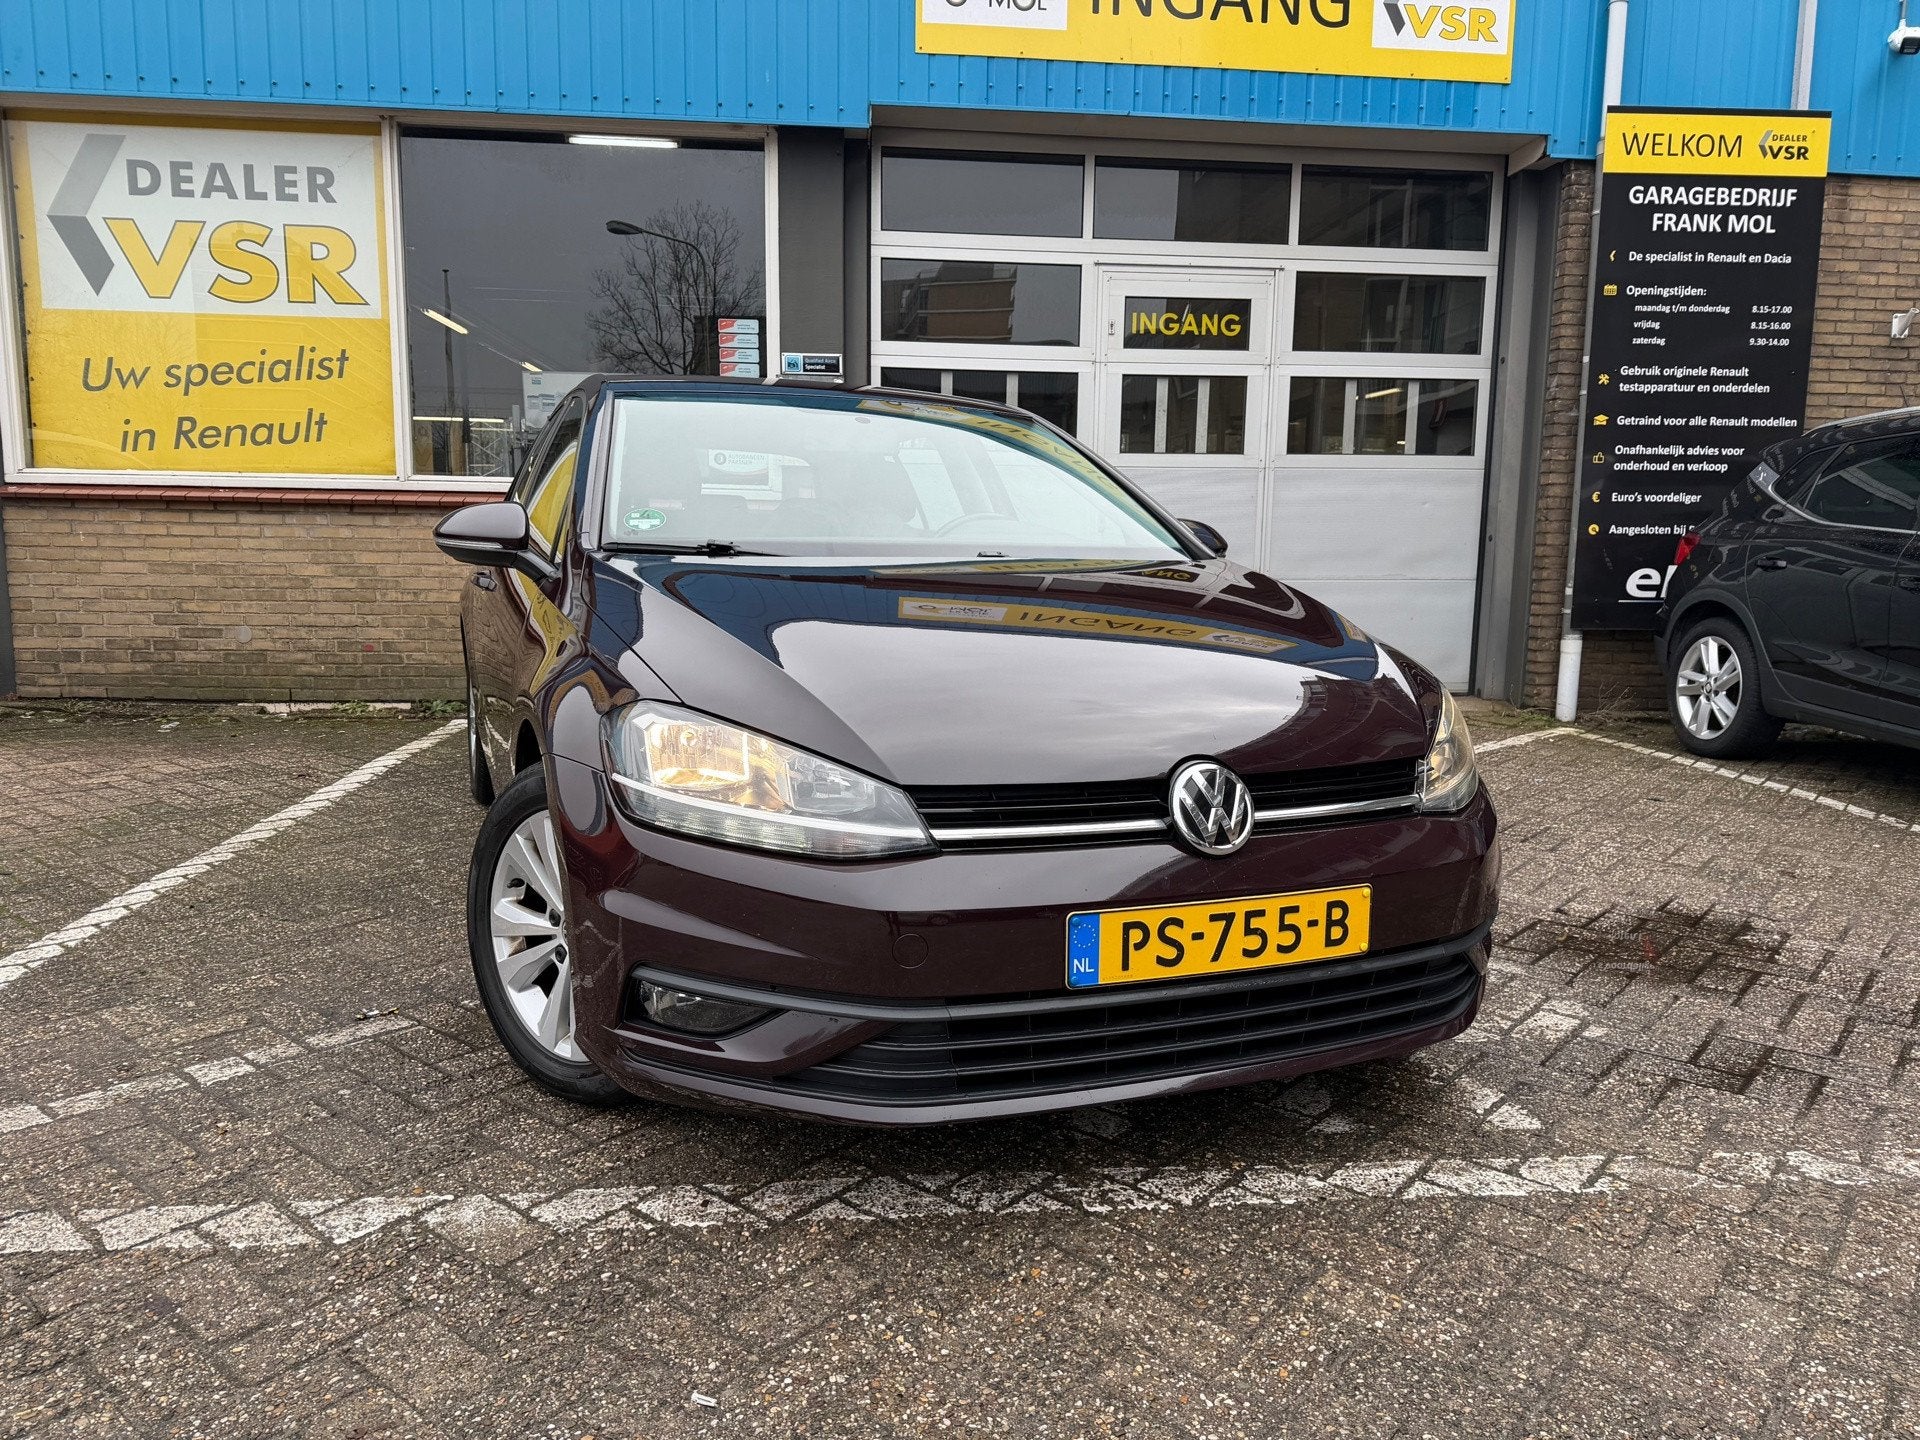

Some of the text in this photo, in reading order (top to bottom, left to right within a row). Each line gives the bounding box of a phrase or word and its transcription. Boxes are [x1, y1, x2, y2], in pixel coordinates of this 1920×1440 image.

[1403, 3, 1499, 42] VSR
[1622, 132, 1743, 158] WELKOM
[1771, 134, 1808, 142] DEALER
[1768, 145, 1810, 161] VSR
[126, 158, 338, 204] DEALER
[1628, 185, 1798, 208] GARAGEBEDRIJF
[1652, 212, 1777, 234] FRANK MOL
[102, 216, 371, 306] VSR
[1628, 251, 1792, 264] De specialist in Renault en Dacia
[1626, 285, 1707, 298] Openingstijden:
[1634, 303, 1793, 314] maandag t/m donderdag 8.15-17.00
[1131, 312, 1242, 337] INGANG
[1633, 319, 1791, 330] vrijdag 8.15-16.00
[1632, 336, 1790, 346] zaterdag 9.30-14.00
[82, 345, 350, 397] Uw specialist
[1620, 365, 1749, 379] Gebruik originele Renault
[1619, 382, 1770, 395] testapparatuur en onderdelen
[1617, 415, 1797, 428] Getraind voor alle Renault modellen
[120, 407, 328, 453] in Renault
[1614, 444, 1745, 457] Onafhankelijk advies voor
[1613, 461, 1728, 474] onderhoud en verkoop
[1644, 492, 1702, 504] voordeliger
[1608, 524, 1671, 536] Aangesloten
[1673, 524, 1687, 537] bij
[1121, 900, 1350, 971] PS-755-B
[1072, 957, 1095, 974] NL
